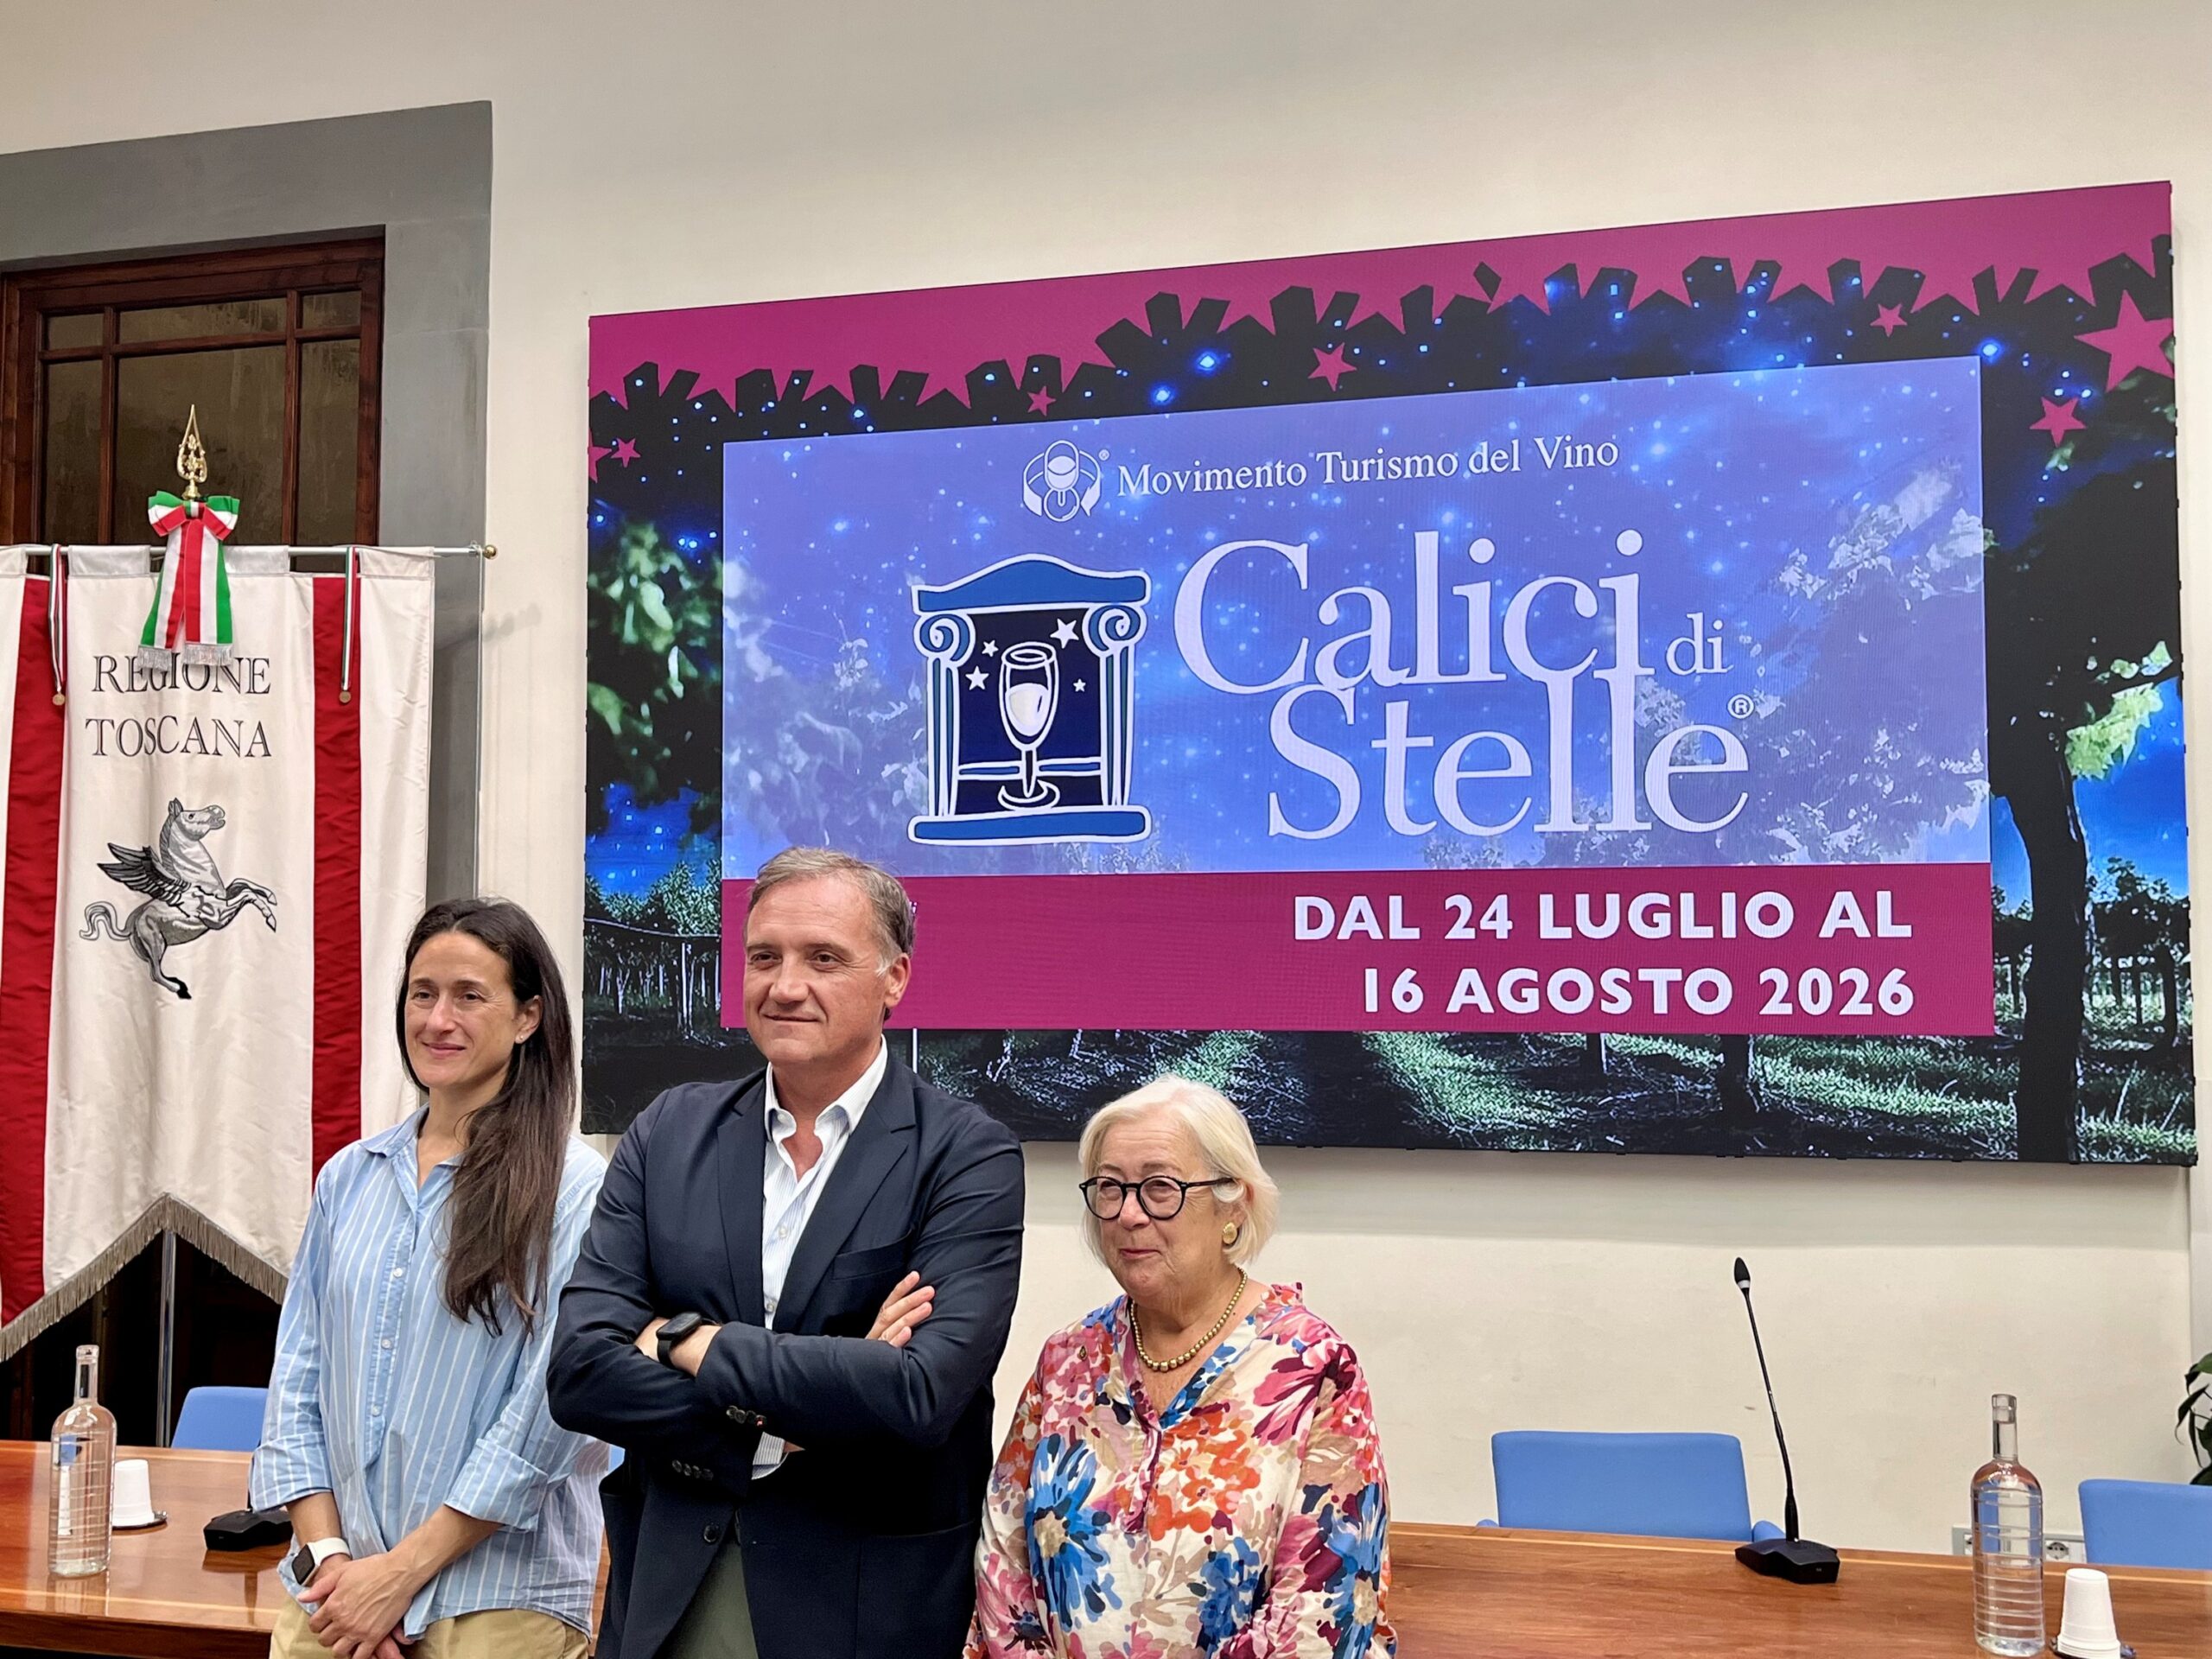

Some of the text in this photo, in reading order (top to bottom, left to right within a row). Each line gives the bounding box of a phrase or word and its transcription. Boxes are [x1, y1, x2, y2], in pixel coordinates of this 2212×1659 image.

[1117, 434, 1620, 497] Movimento Turismo del Vino
[1173, 529, 1733, 695] Calici di
[92, 652, 271, 694] REGIONE
[85, 715, 272, 758] TOSCANA
[1268, 671, 1750, 840] Stelle
[1294, 890, 1913, 940] DAL 24 LUGLIO AL
[1364, 967, 1915, 1016] 16 AGOSTO 2026
